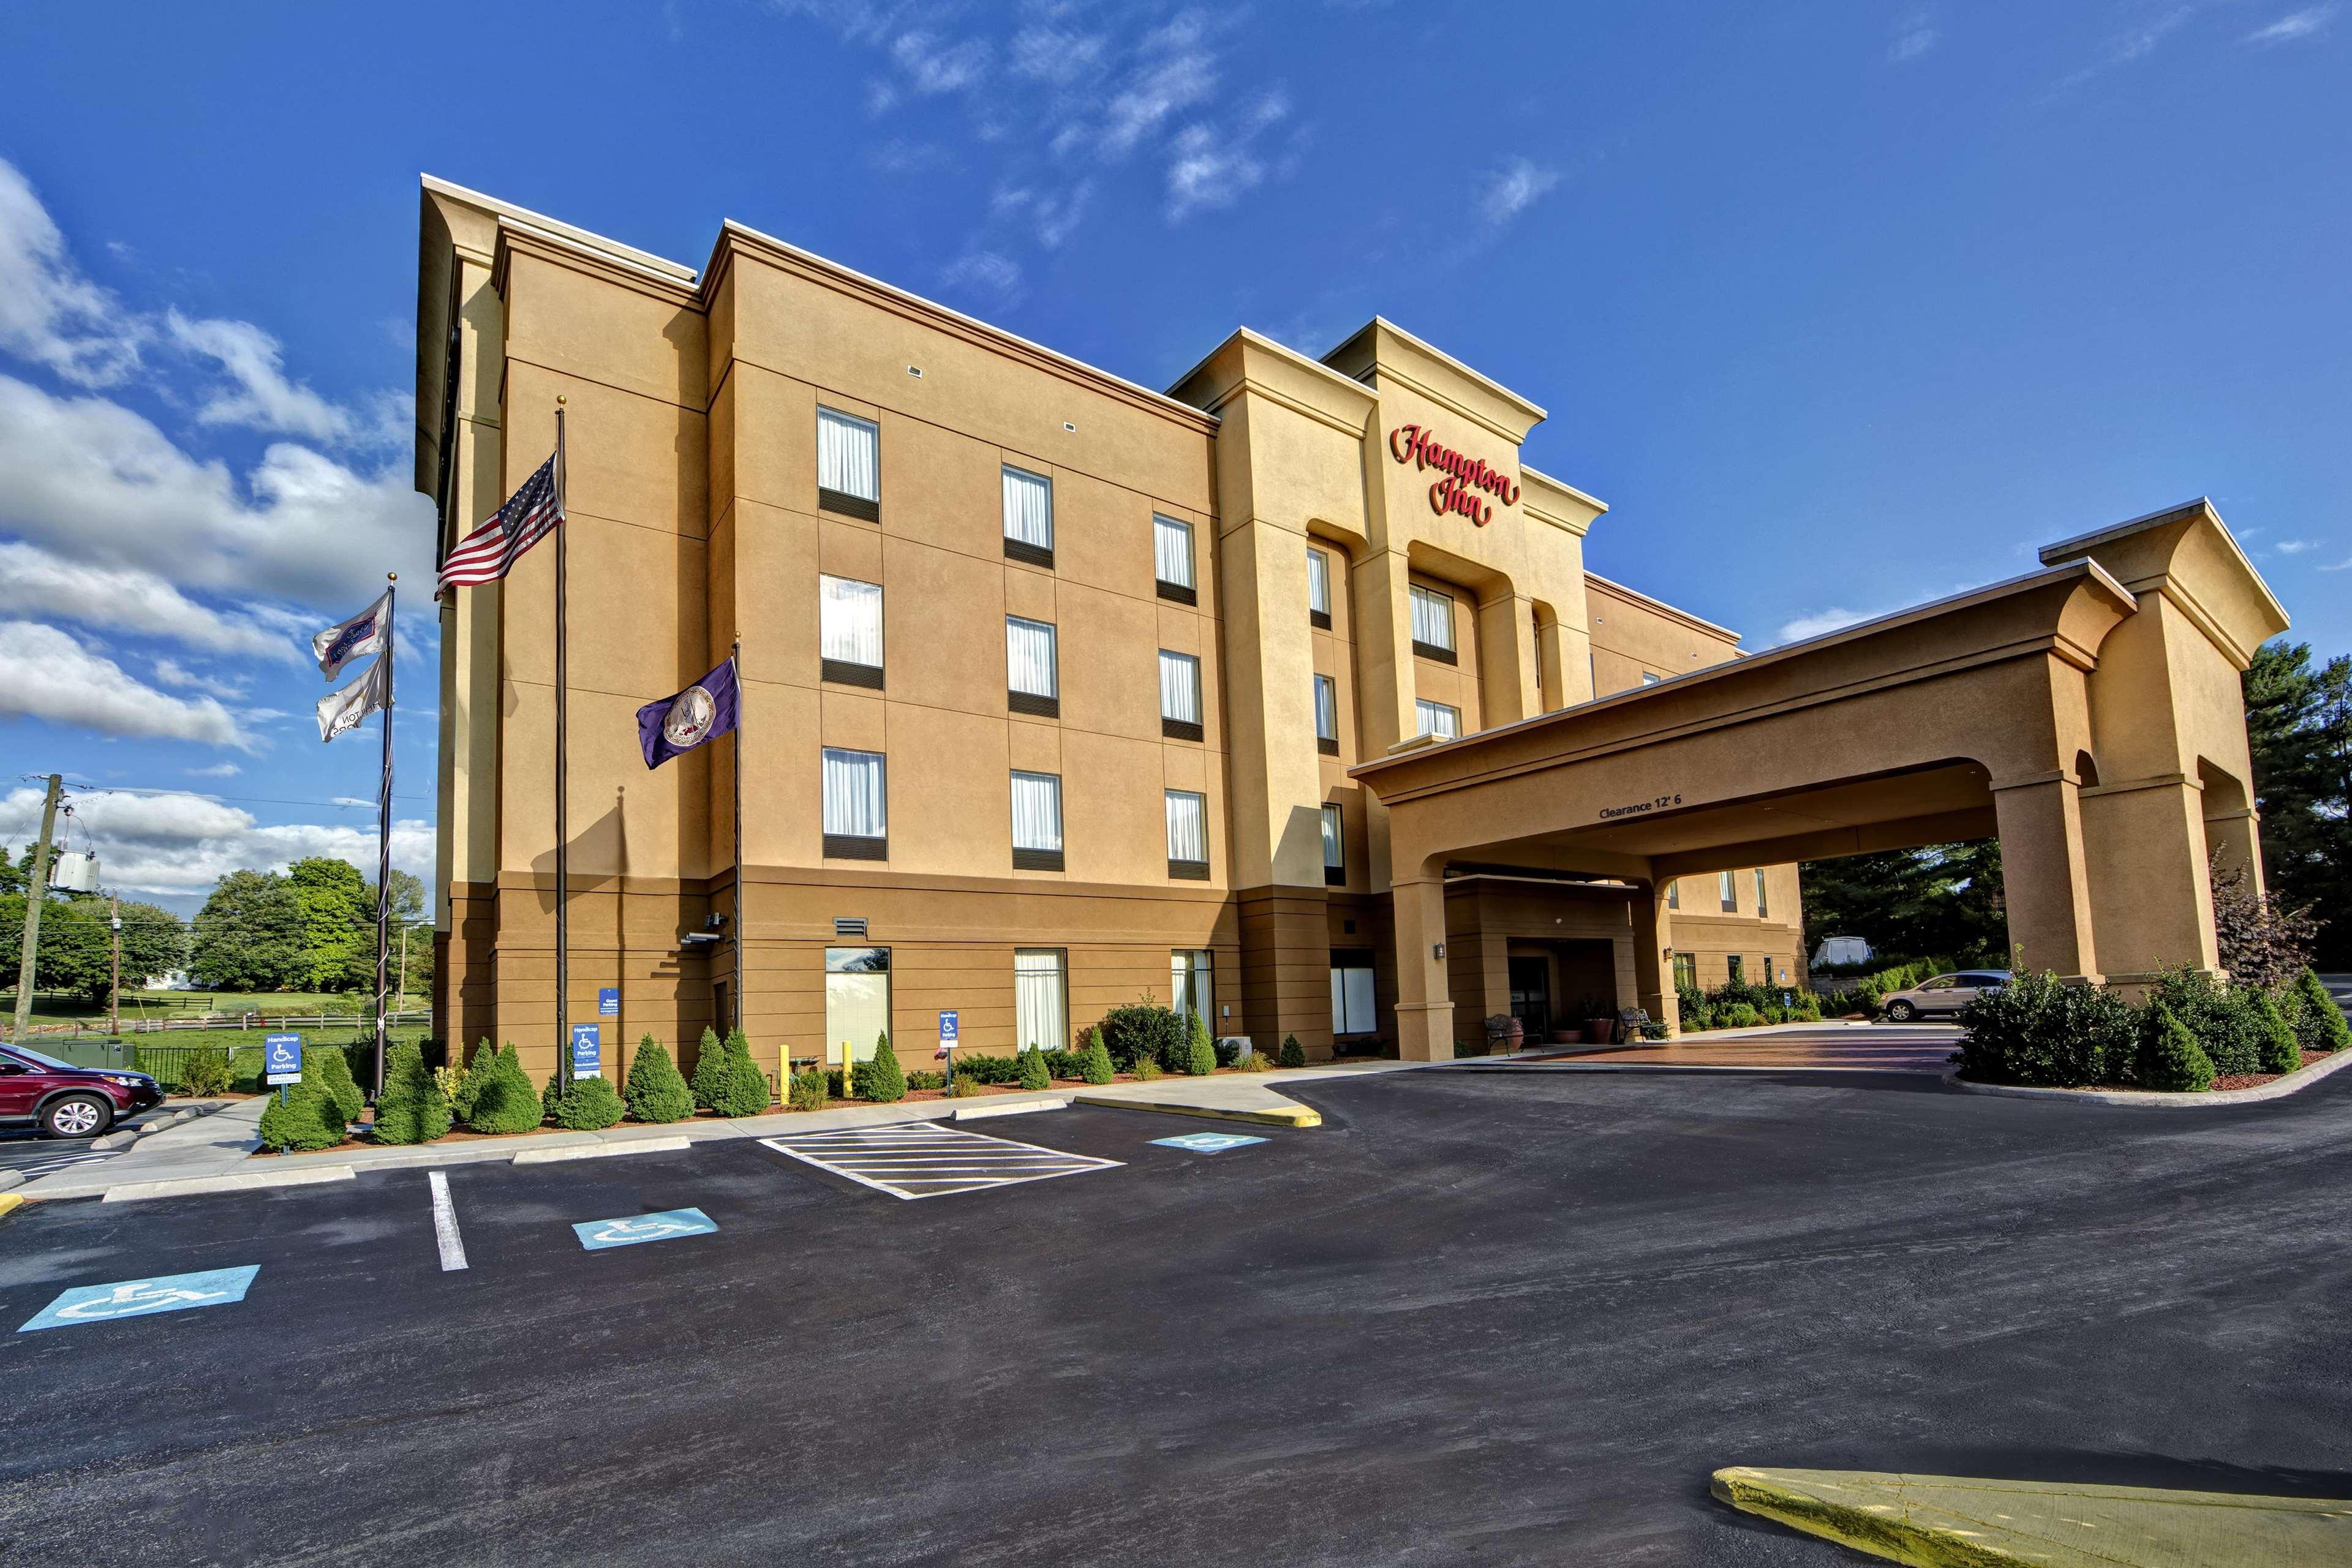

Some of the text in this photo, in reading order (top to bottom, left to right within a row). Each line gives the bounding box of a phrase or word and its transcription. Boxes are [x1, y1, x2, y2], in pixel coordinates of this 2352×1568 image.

[1390, 424, 1520, 505] Hampton
[1429, 477, 1491, 527] Inn
[1599, 802, 1652, 819] Clearance
[1674, 794, 1682, 804] 6
